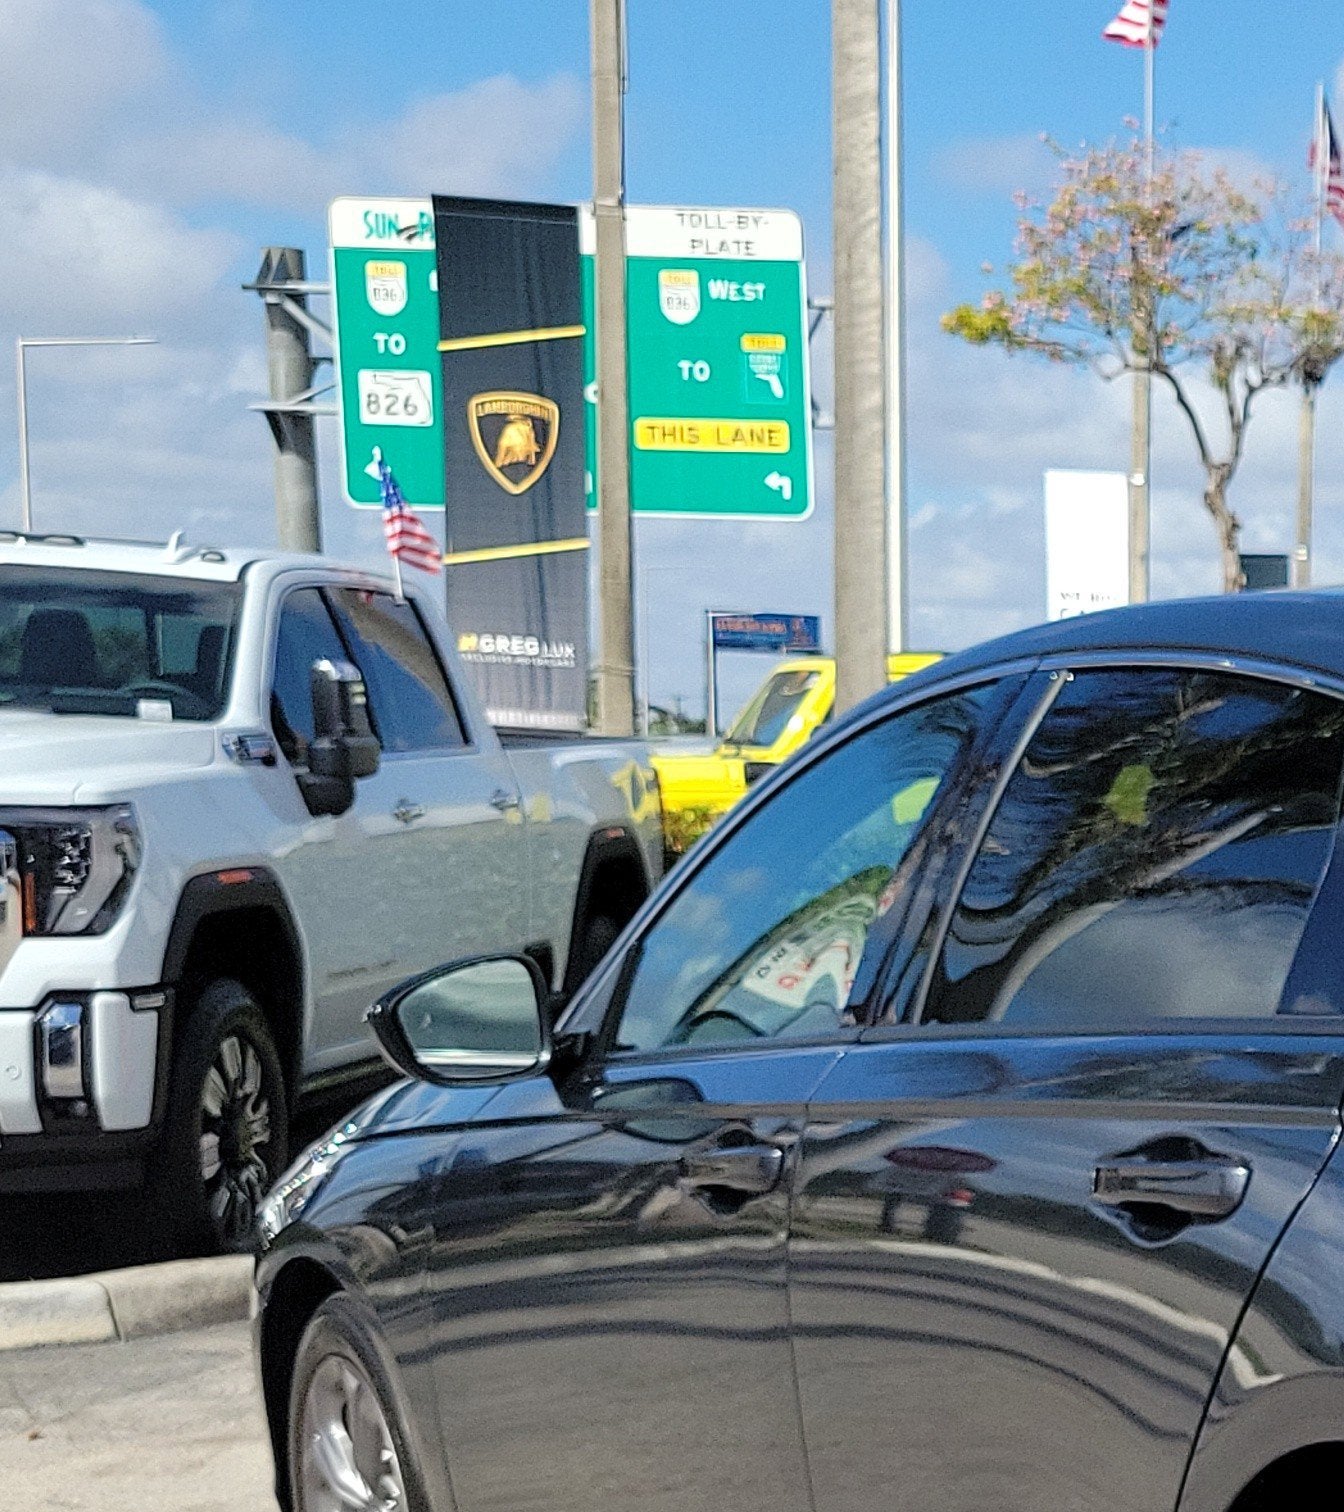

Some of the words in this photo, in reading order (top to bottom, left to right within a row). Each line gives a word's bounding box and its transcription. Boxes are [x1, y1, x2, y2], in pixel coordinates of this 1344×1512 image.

[689, 238, 758, 256] PLATE
[707, 278, 767, 302] WEST
[372, 332, 407, 356] TO
[677, 359, 711, 382] TO
[366, 392, 418, 416] 826
[646, 425, 700, 444] THIS
[716, 427, 781, 447] LANE
[540, 640, 576, 658] LUX
